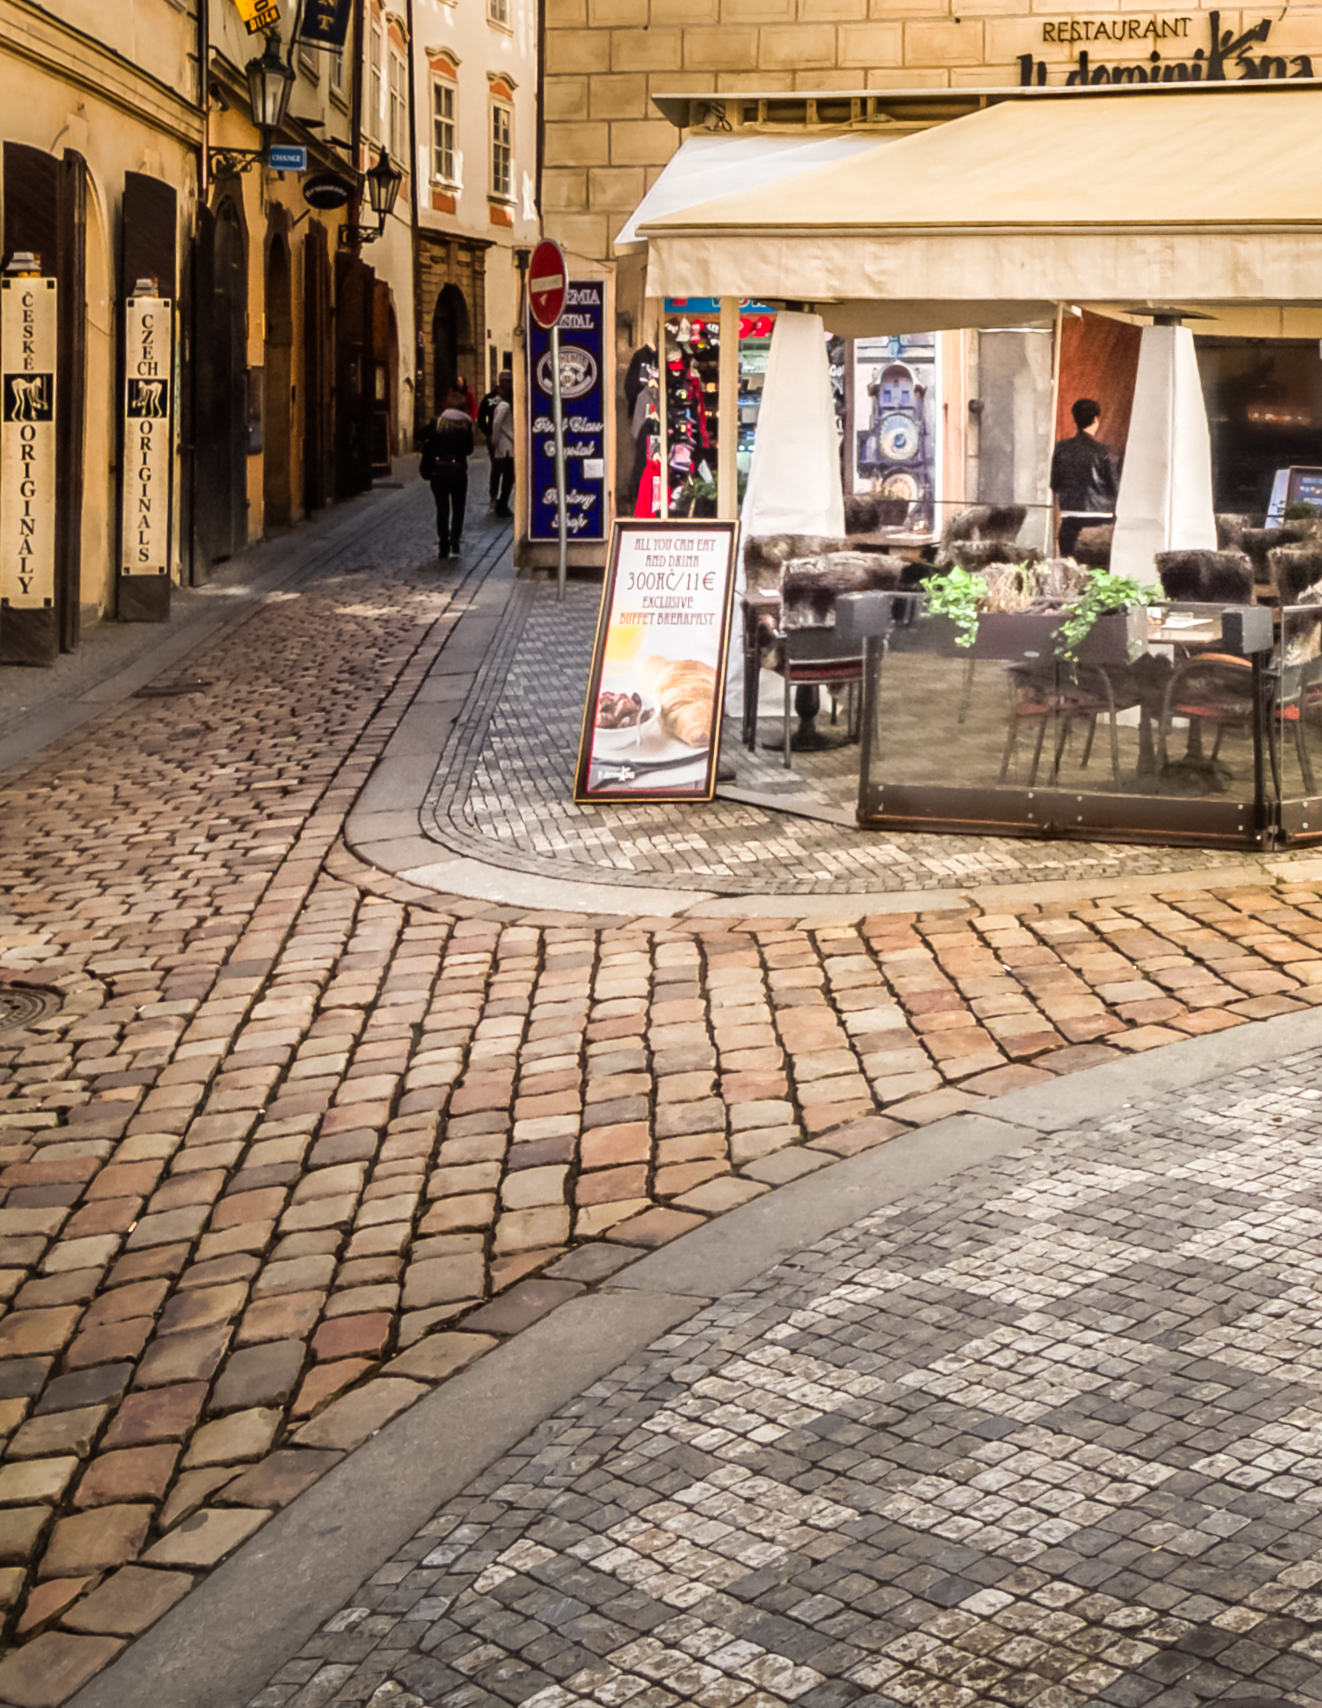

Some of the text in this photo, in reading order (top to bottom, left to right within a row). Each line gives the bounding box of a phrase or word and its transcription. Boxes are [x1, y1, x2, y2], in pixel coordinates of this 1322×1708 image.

[1043, 17, 1192, 42] RESTAURANT
[271, 153, 301, 163] CHANGE
[21, 291, 35, 371] ČESKÉ
[136, 313, 159, 377] CZECH
[137, 420, 152, 562] ORIGINALS
[18, 424, 36, 595] ORIGINÁLY
[634, 538, 716, 551] ALL YOU CAN EAT
[645, 555, 700, 567] AND DRINK
[642, 596, 694, 609] EXCLUSIVE
[619, 612, 715, 626] BUFFET BREAKFAST
